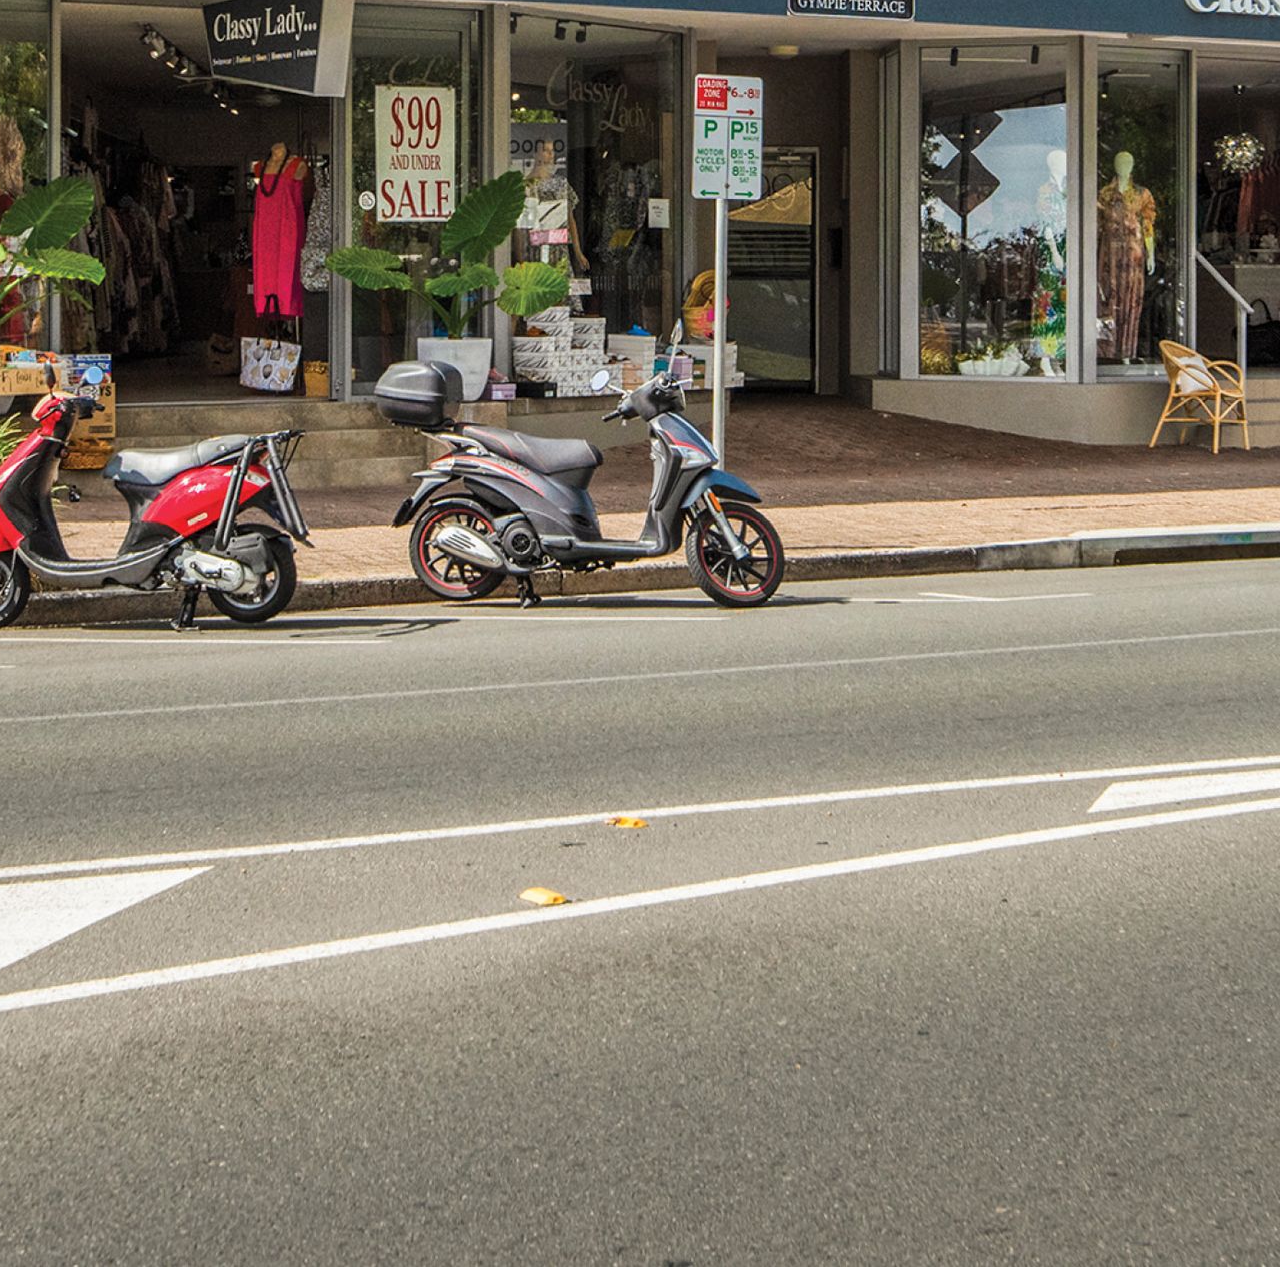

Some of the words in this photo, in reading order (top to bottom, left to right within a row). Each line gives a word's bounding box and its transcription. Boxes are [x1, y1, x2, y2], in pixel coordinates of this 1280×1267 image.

[213, 12, 262, 46] Classy
[263, 4, 318, 42] Lady...
[698, 78, 726, 89] LOADING
[703, 88, 722, 99] ZONE
[390, 91, 443, 153] $99
[704, 119, 718, 139] P
[697, 148, 724, 156] MOTOR
[389, 154, 409, 171] AND
[411, 154, 442, 171] UNDER
[695, 156, 726, 165] CYCLES
[699, 165, 722, 173] ONLY
[380, 179, 453, 220] SALE
